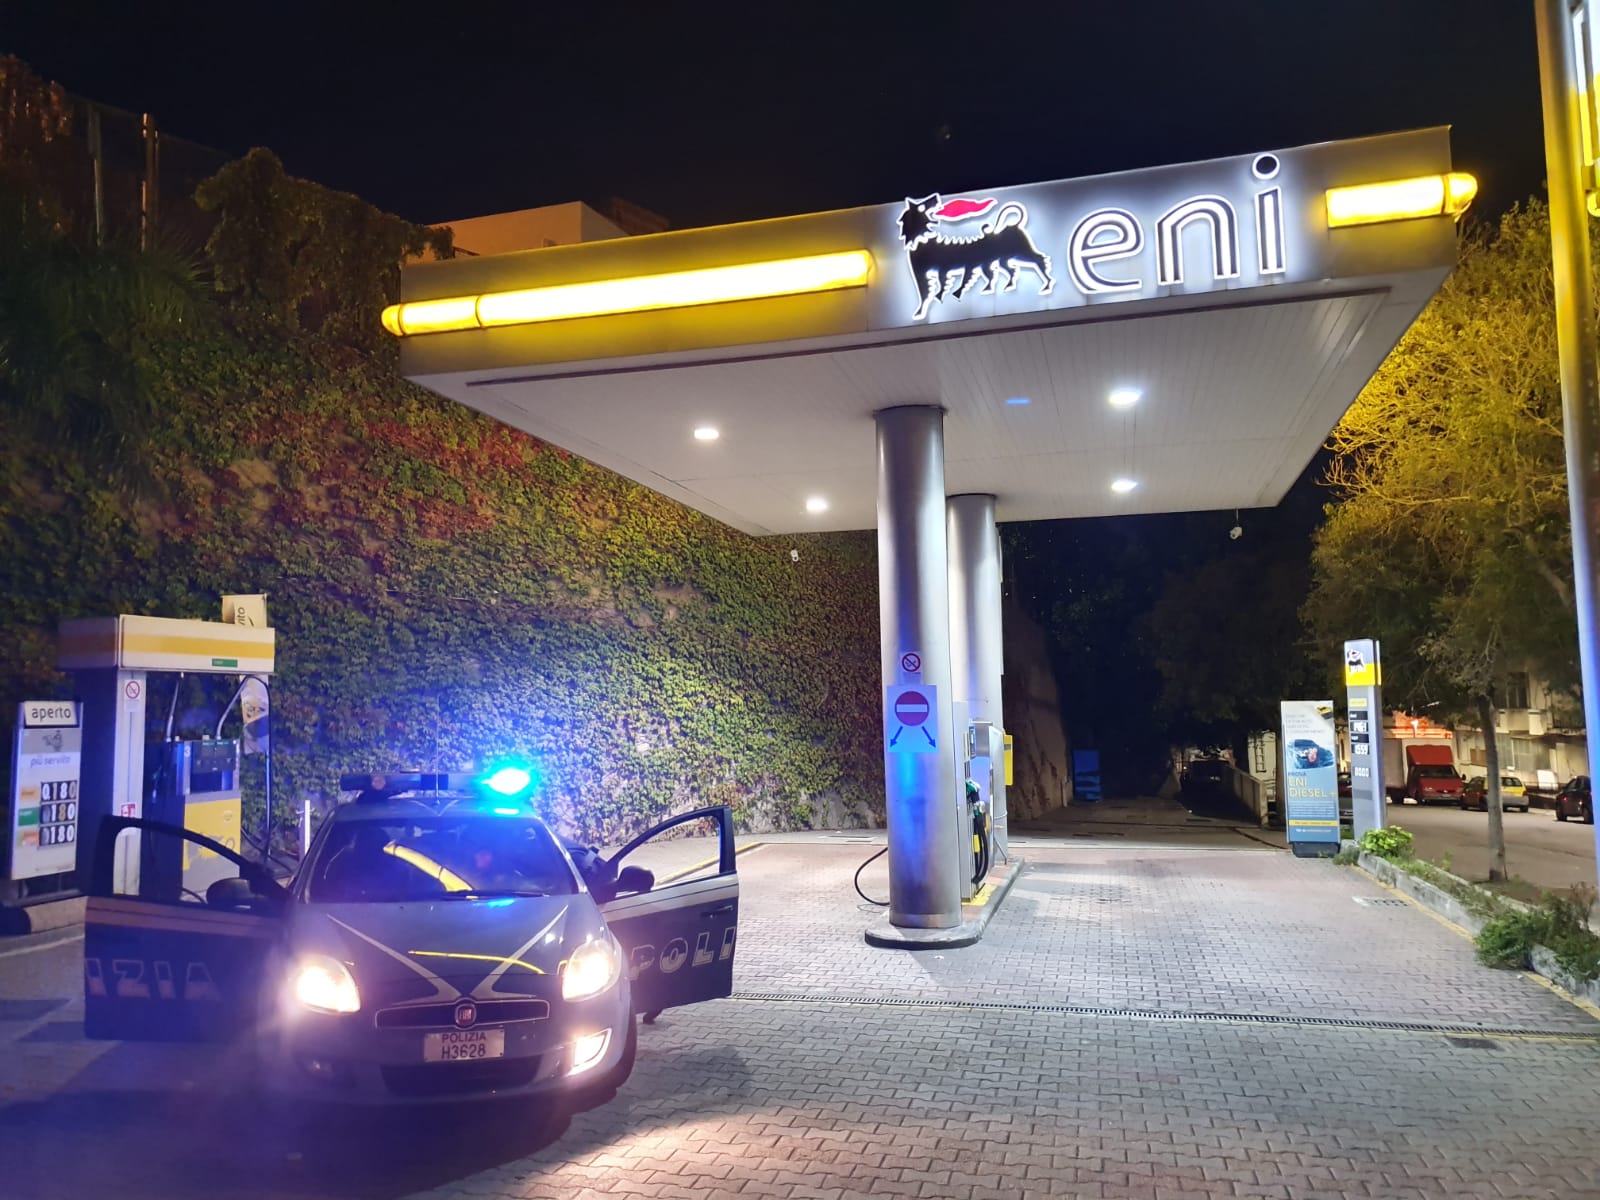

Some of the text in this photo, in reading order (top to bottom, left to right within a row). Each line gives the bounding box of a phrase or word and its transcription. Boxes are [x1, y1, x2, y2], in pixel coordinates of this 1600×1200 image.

[1067, 153, 1286, 294] eni
[31, 707, 72, 721] aperto
[1288, 777, 1307, 787] ENI
[1289, 788, 1327, 798] DIESEL
[627, 926, 736, 980] POLI
[84, 958, 223, 1001] IZIA
[441, 1032, 487, 1043] POLIZIA
[441, 1043, 487, 1059] H3628
